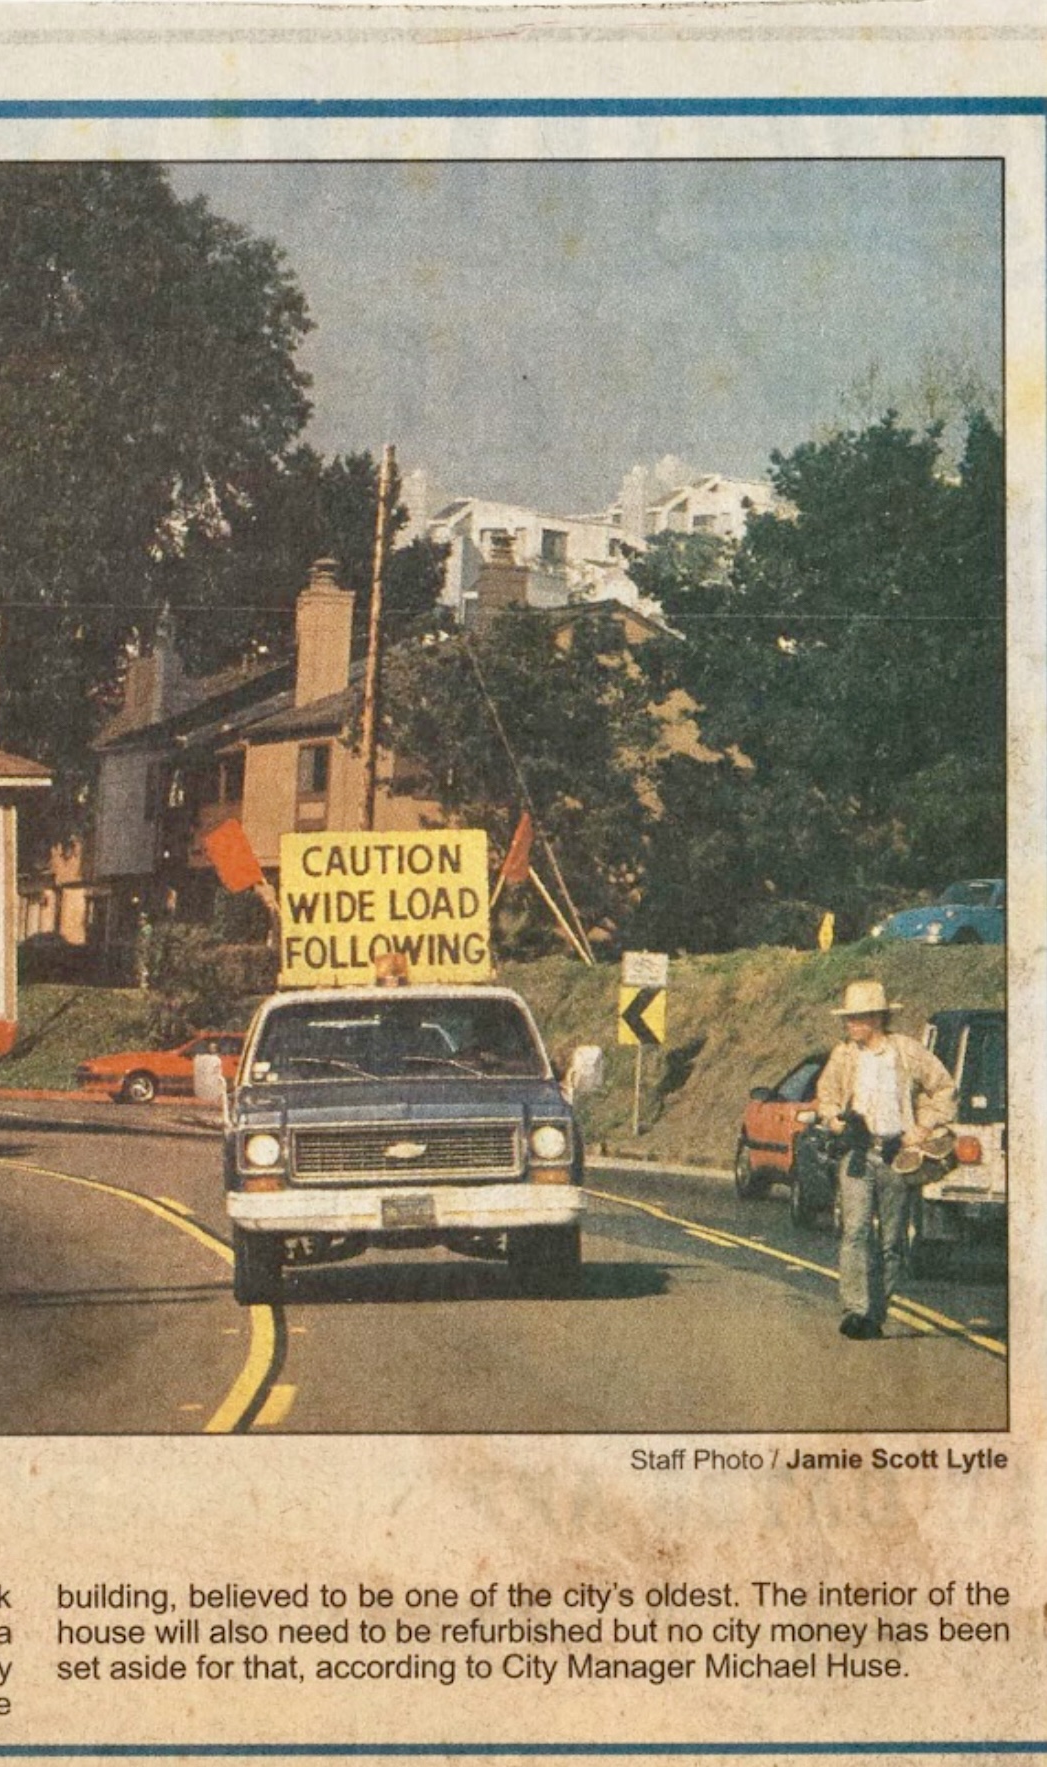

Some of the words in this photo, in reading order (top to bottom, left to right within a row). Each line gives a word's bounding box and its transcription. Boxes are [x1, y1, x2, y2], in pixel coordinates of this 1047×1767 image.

[301, 844, 462, 877] CAUTION
[287, 890, 375, 924] WIDE
[389, 887, 480, 920] LOAD
[285, 932, 486, 970] FOLLOWING
[630, 1448, 687, 1471] Staff
[693, 1448, 764, 1471] Photo
[771, 1448, 779, 1470] /
[785, 1448, 863, 1470] Jamie
[871, 1448, 939, 1470] Scott
[947, 1447, 1009, 1475] Lytle
[57, 1582, 176, 1615] building,
[188, 1582, 309, 1609] believed
[319, 1583, 348, 1609] to
[358, 1582, 394, 1609] be
[405, 1587, 459, 1609] one
[469, 1581, 499, 1609] of
[507, 1581, 553, 1608] the
[645, 1581, 740, 1608] oldest.
[750, 1581, 808, 1607] The
[818, 1580, 918, 1607] interior
[927, 1580, 957, 1608] of
[965, 1580, 1011, 1607] the
[57, 1618, 146, 1645] house
[154, 1618, 200, 1645] will
[208, 1618, 269, 1645] also
[278, 1618, 349, 1644] need
[359, 1619, 387, 1644] to
[395, 1618, 432, 1644] be
[441, 1617, 603, 1644] refurbished
[613, 1617, 658, 1644] but
[667, 1623, 704, 1644] no
[712, 1617, 762, 1650] city
[770, 1622, 868, 1649] money
[877, 1616, 929, 1643] has
[939, 1616, 1010, 1643] been
[56, 1655, 101, 1681] set
[109, 1654, 187, 1681] aside
[195, 1653, 235, 1681] for
[242, 1654, 305, 1684] that,
[315, 1653, 456, 1686] according
[465, 1654, 493, 1680] to
[501, 1653, 559, 1686] City
[567, 1653, 697, 1686] Manager
[705, 1652, 816, 1679] Michael
[826, 1652, 909, 1679] Huse.
